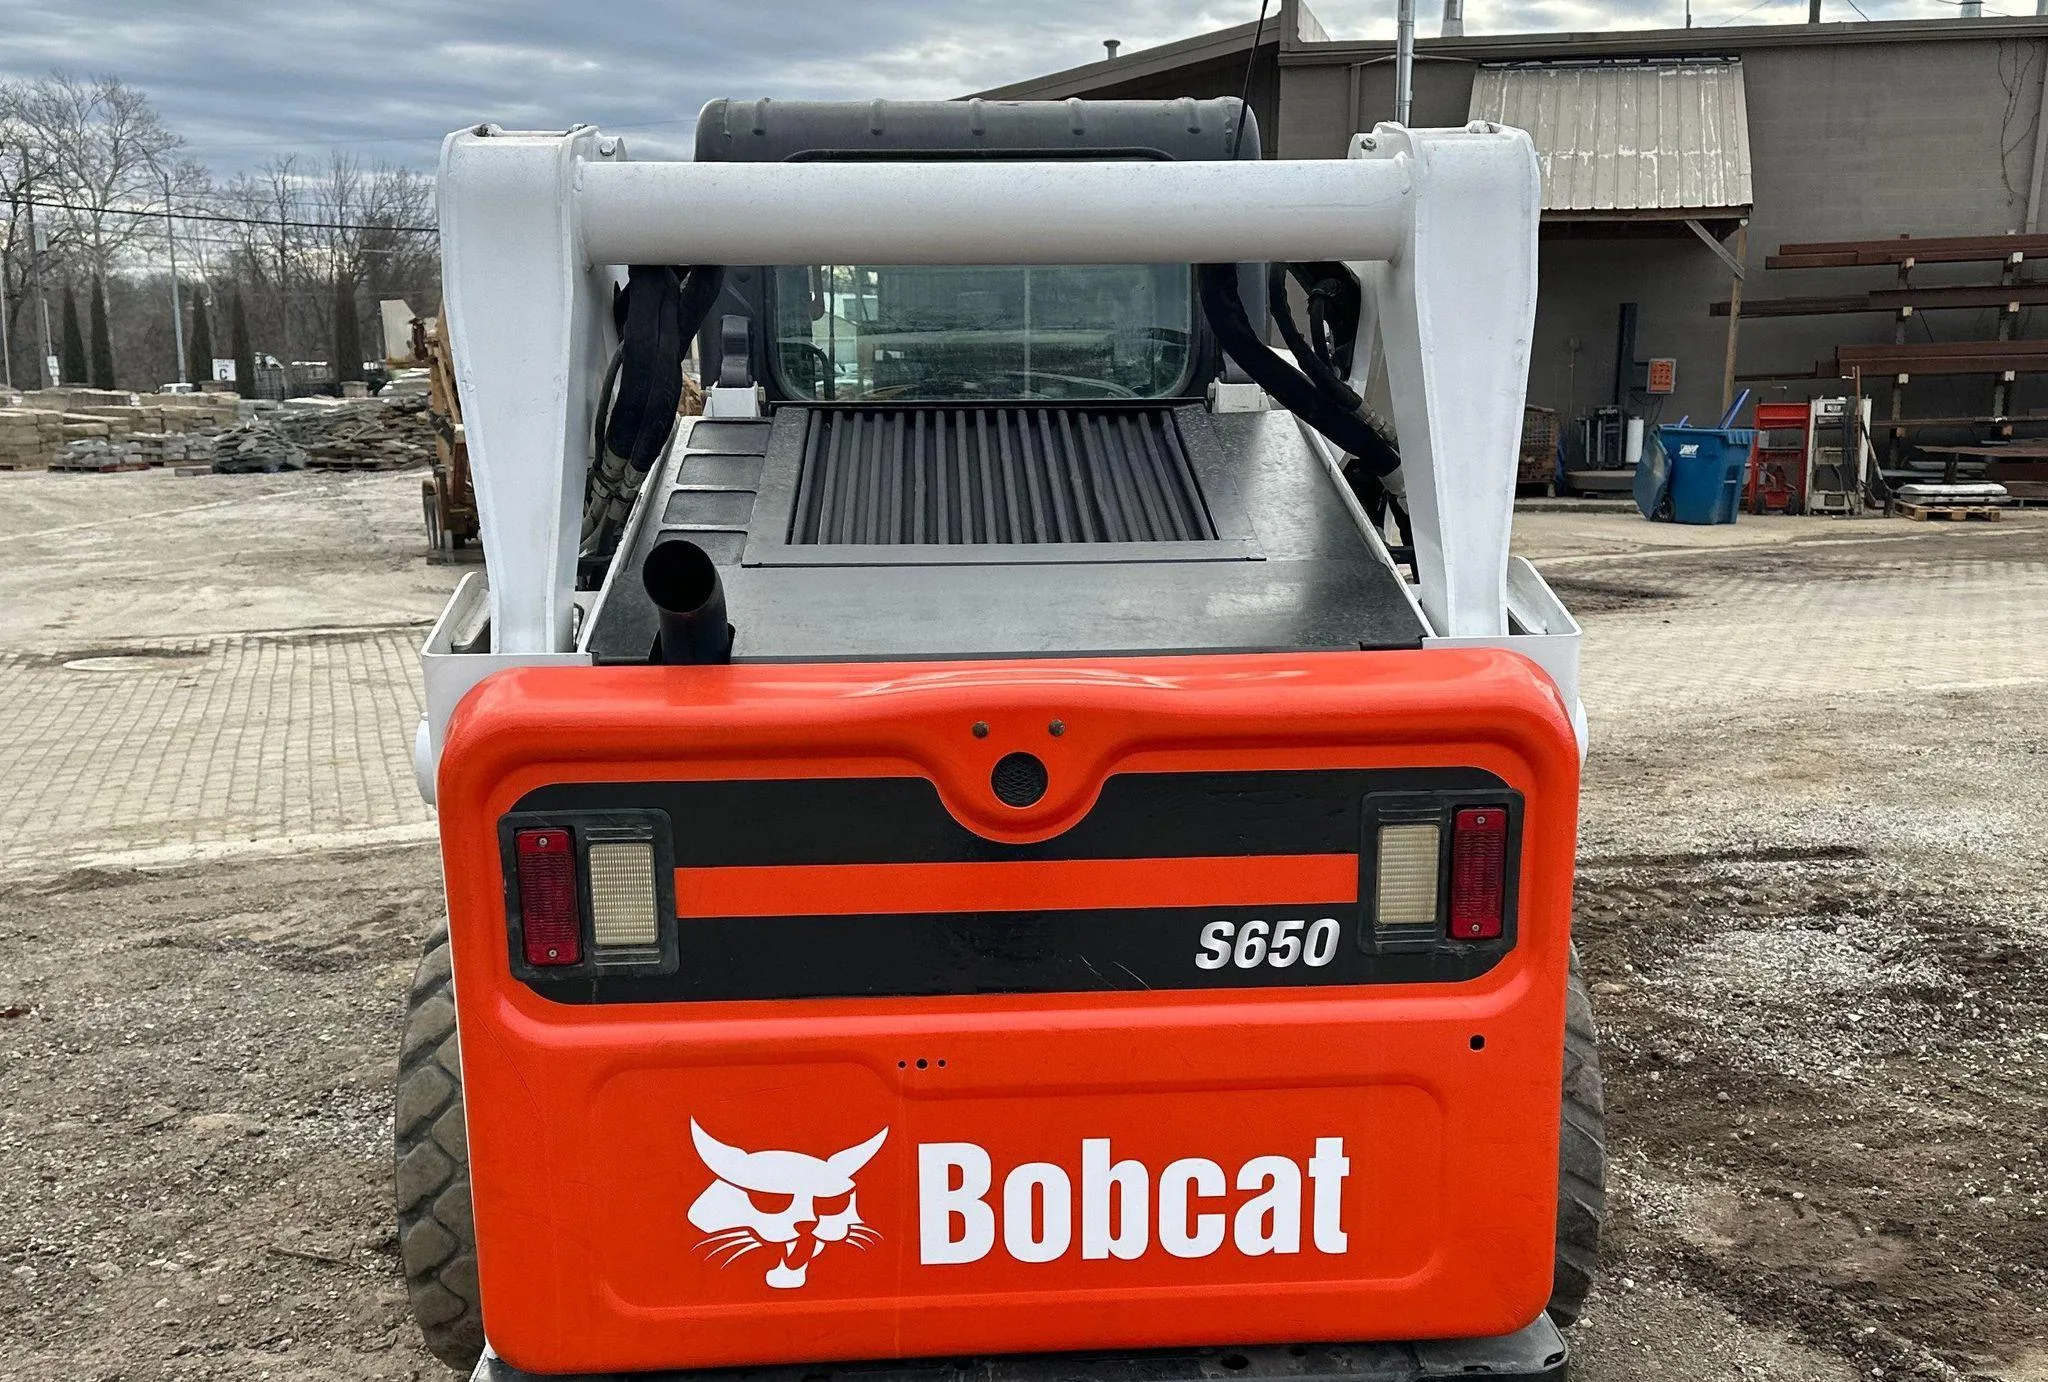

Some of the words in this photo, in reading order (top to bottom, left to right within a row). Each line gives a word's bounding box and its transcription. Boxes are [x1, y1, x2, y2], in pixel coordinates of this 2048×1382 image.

[219, 368, 228, 380] C
[1195, 918, 1341, 970] S650
[918, 1136, 1350, 1266] Bobcat
